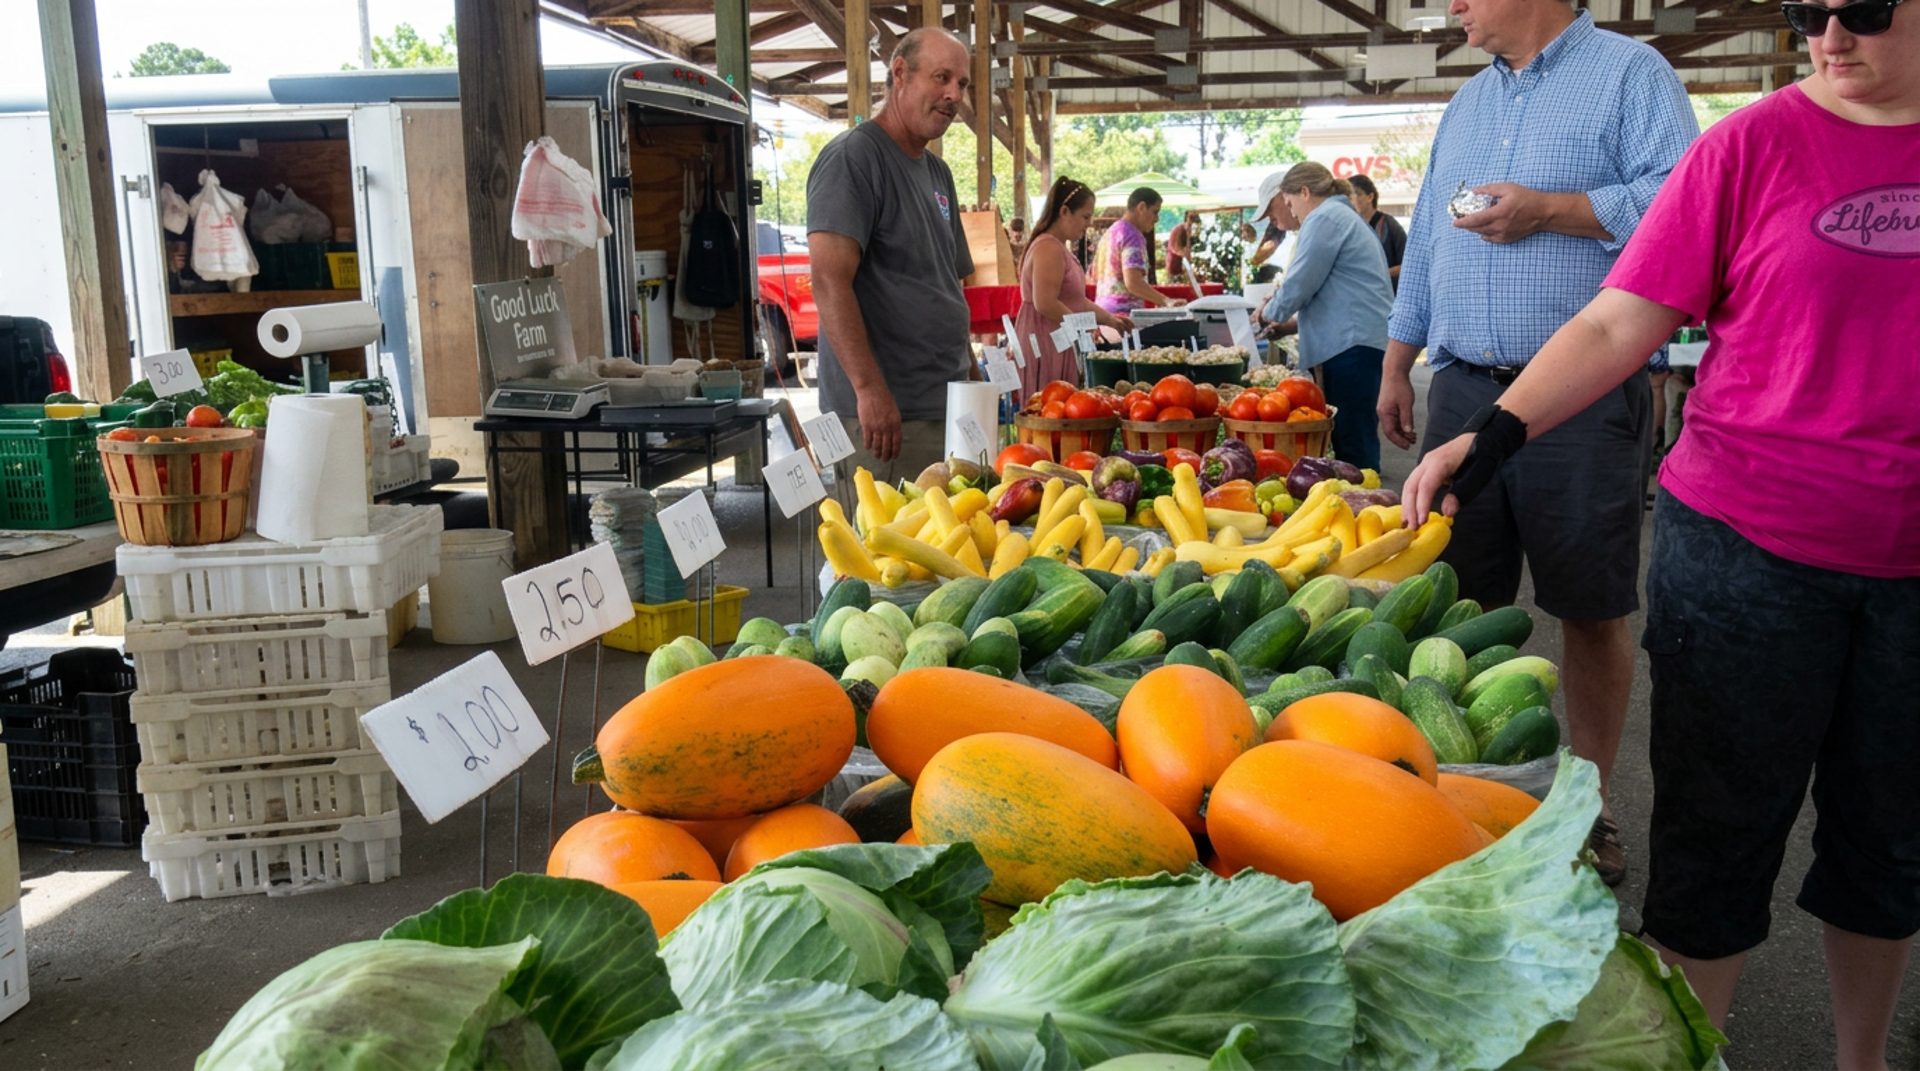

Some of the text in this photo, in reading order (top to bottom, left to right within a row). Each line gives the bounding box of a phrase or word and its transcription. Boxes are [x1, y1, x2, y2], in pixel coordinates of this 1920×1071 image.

[1332, 155, 1393, 180] CVS
[490, 284, 560, 323] Good Luck
[513, 322, 548, 350] Farm
